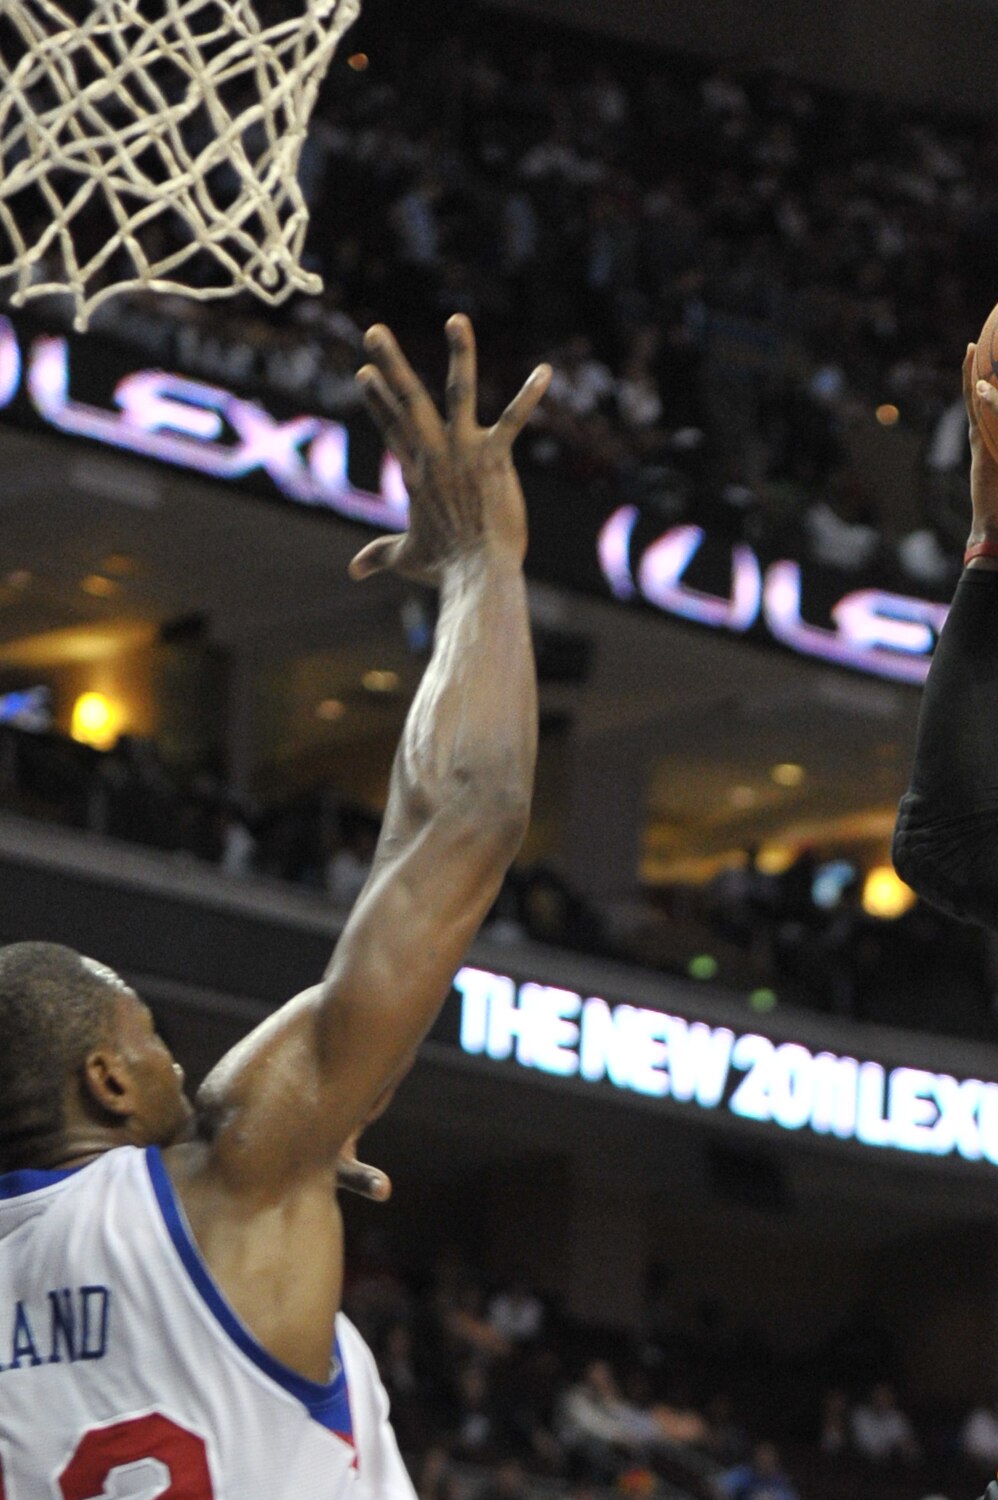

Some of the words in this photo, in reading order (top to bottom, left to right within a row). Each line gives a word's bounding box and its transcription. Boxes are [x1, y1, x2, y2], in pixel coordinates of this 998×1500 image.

[26, 334, 410, 532] LEXU
[454, 967, 581, 1076] THE
[580, 997, 735, 1108] NEW
[0, 1285, 109, 1372] AND
